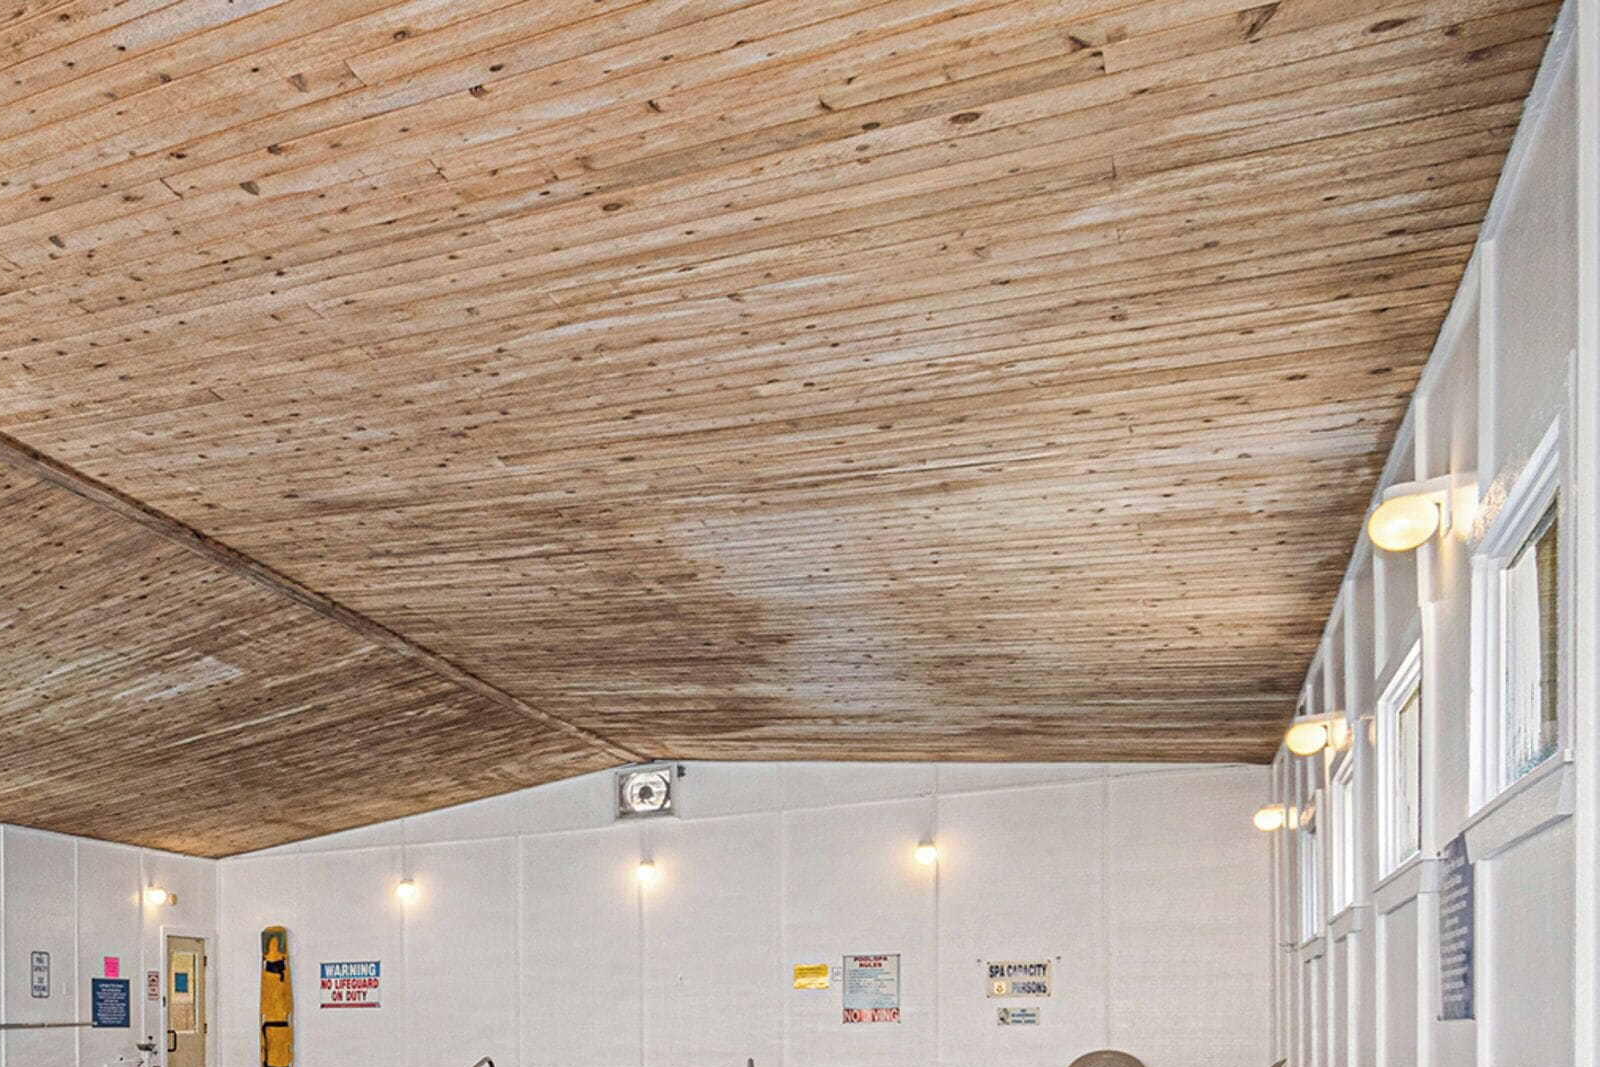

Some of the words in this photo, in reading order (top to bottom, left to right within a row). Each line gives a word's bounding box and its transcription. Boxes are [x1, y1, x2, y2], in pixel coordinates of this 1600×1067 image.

[325, 963, 376, 977] WARNING
[988, 965, 1005, 978] SPA
[1007, 963, 1048, 977] CAPACITY
[321, 979, 332, 990] NO
[335, 978, 379, 990] LIFEGUARD
[1012, 981, 1048, 994] PERSONS
[331, 990, 343, 1001] ON
[346, 990, 367, 1001] DUTY
[844, 1008, 861, 1022] NO
